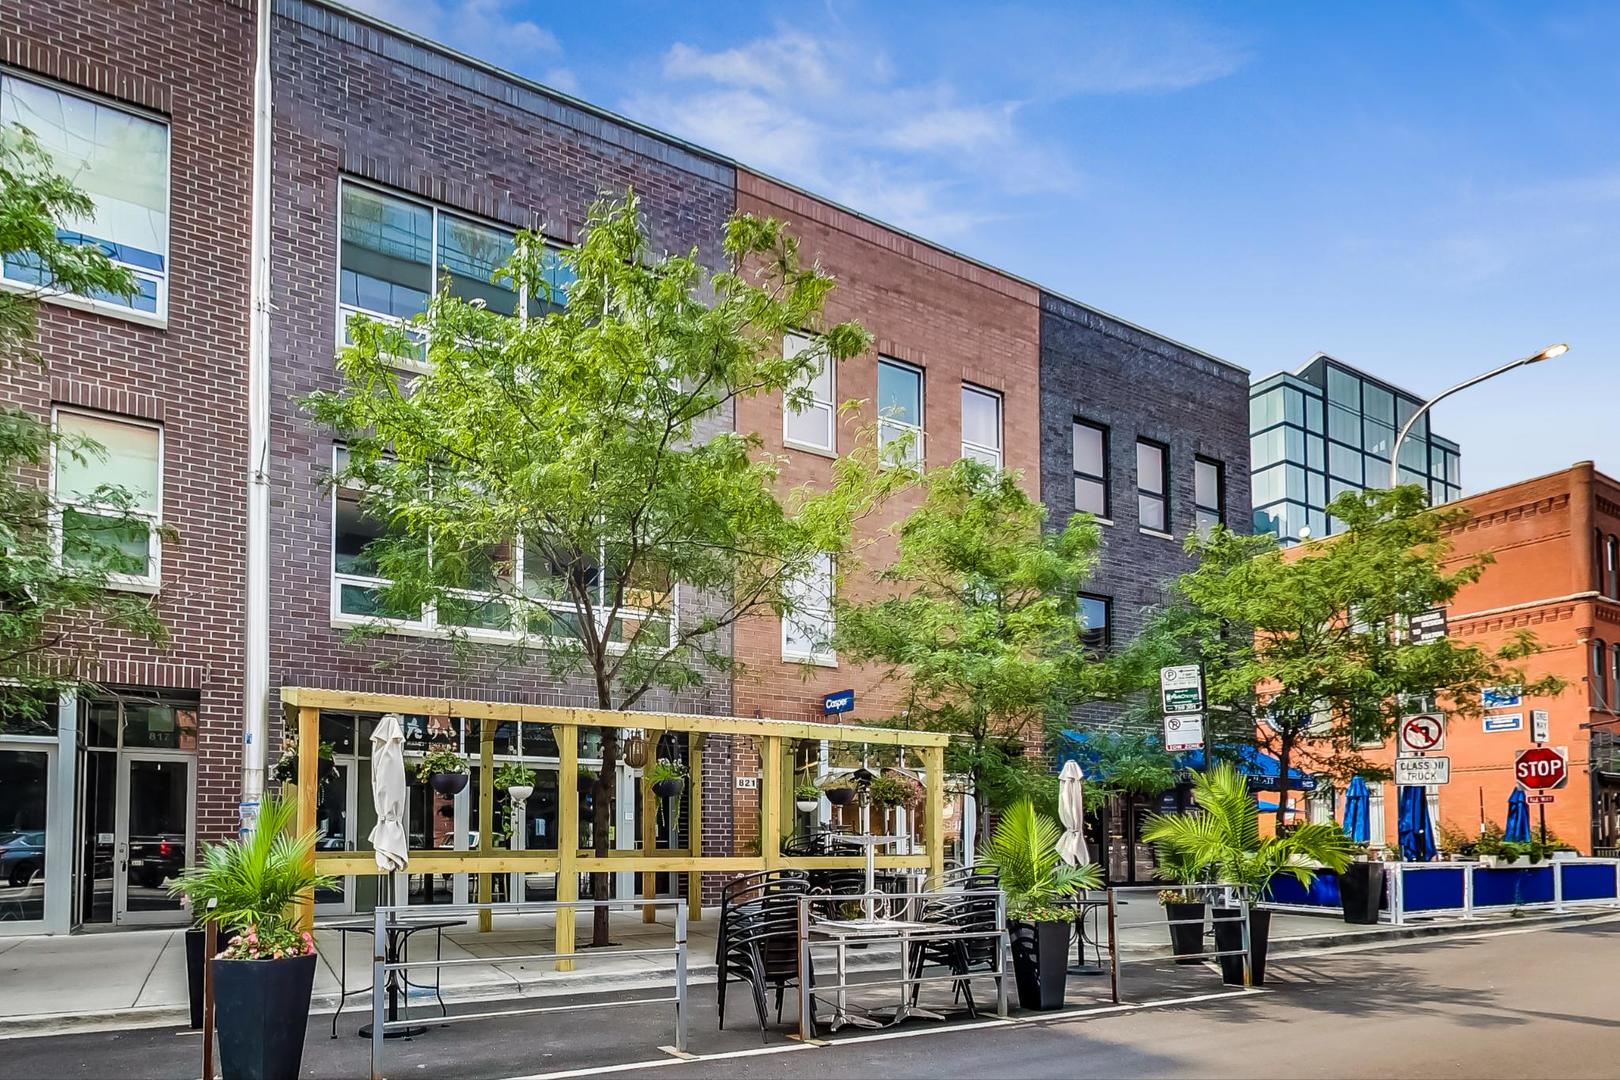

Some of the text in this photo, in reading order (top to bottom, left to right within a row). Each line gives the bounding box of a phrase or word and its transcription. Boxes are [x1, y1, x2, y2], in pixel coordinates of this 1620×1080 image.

[825, 697, 849, 710] Casper
[148, 732, 171, 741] 817
[1400, 761, 1430, 770] CLASS
[1518, 759, 1562, 777] STOP
[1407, 771, 1437, 780] TRUCK
[739, 779, 755, 787] 821
